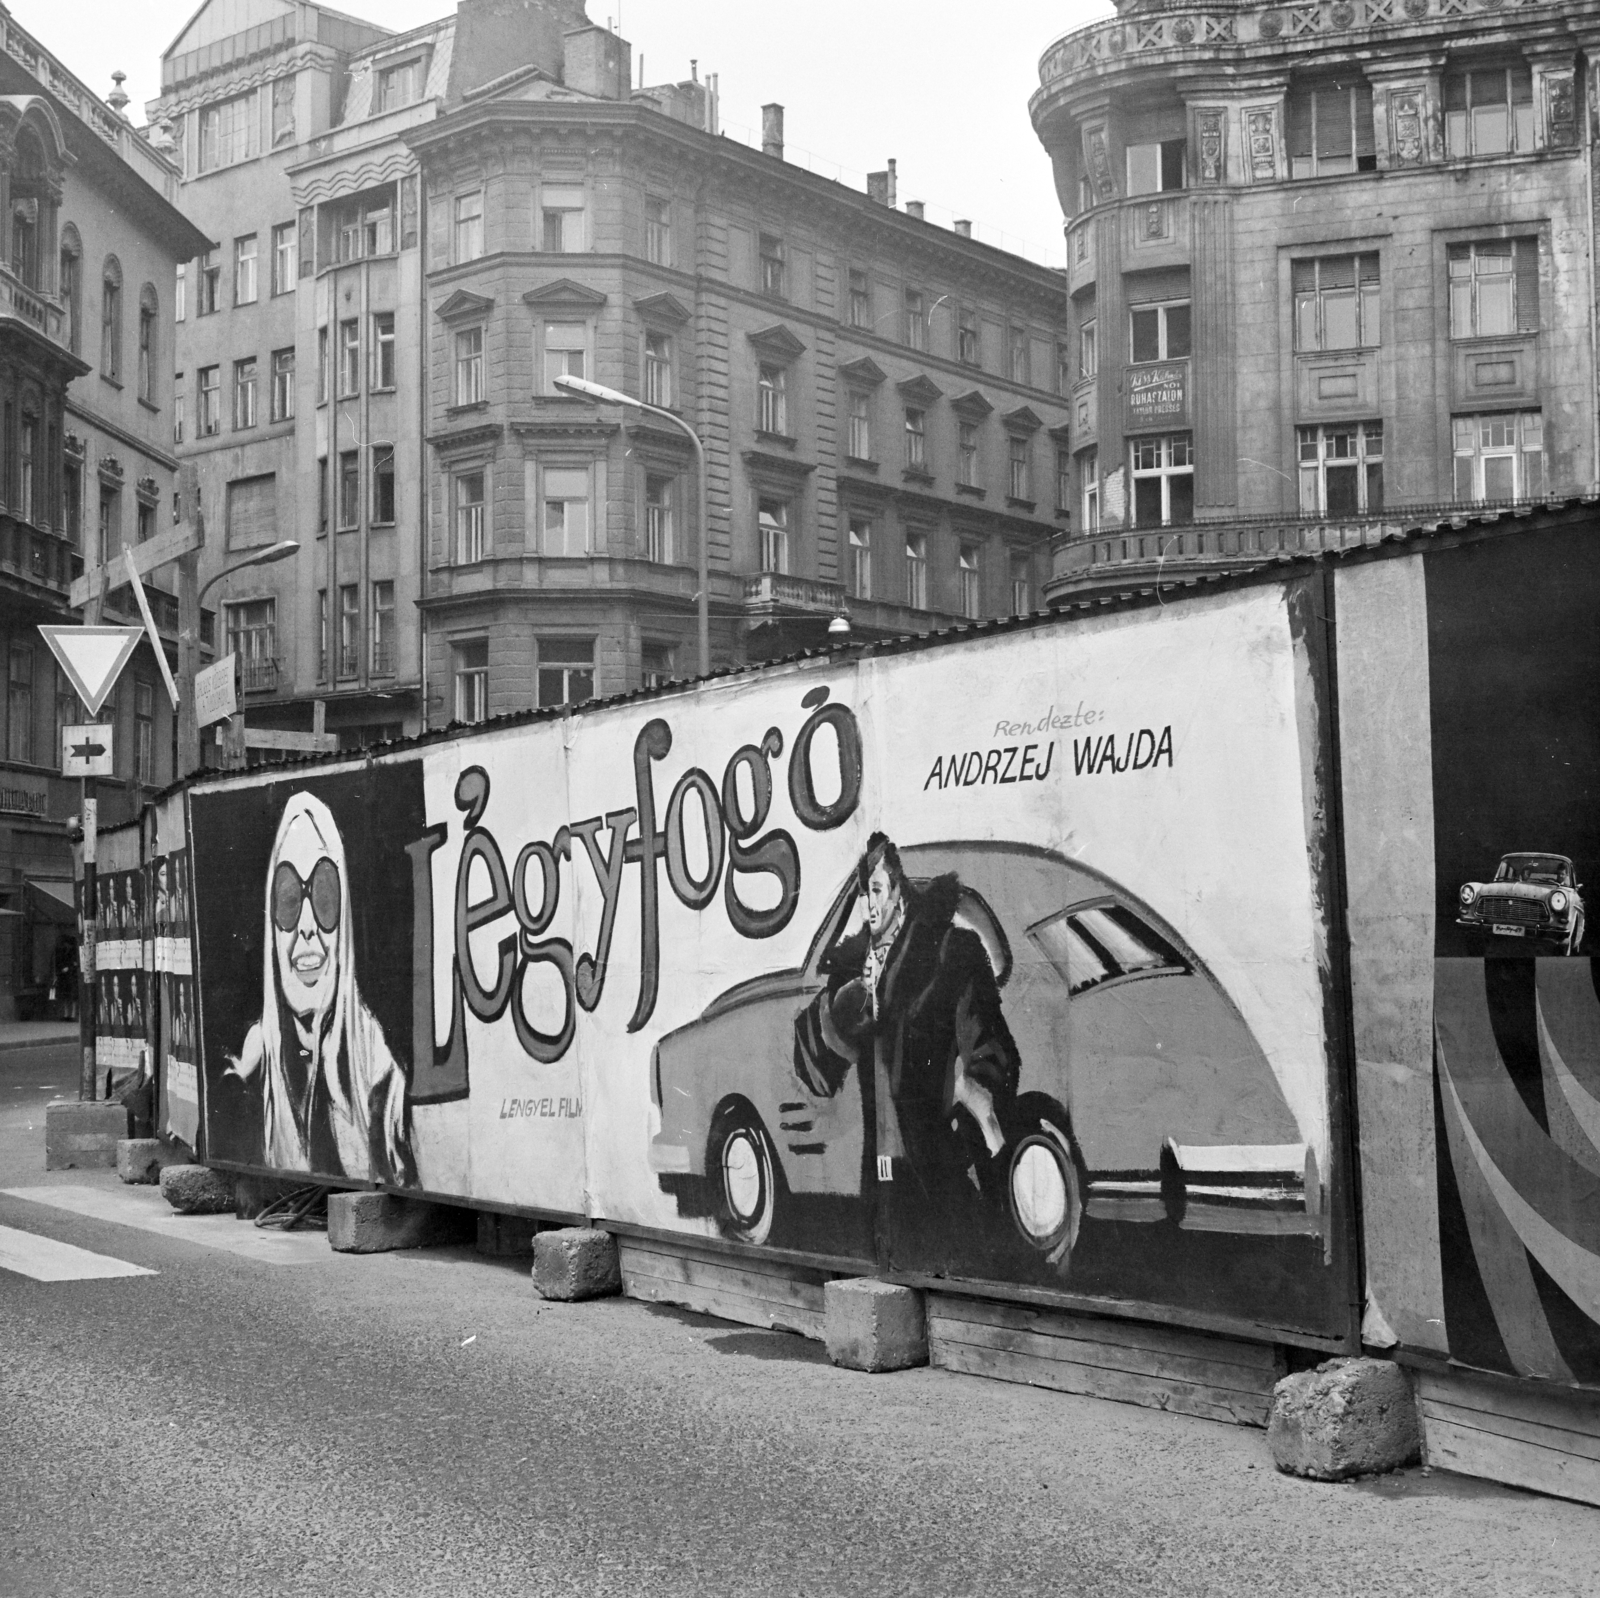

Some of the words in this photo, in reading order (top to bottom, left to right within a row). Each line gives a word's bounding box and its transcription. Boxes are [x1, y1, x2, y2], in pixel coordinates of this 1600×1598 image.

[1130, 389, 1183, 405] RUHASZALON
[993, 701, 1104, 738] Rendezte:
[923, 741, 1054, 791] ANDRZEJ
[1073, 725, 1173, 776] WAJDA
[404, 686, 863, 1105] Légyfogó
[499, 1098, 556, 1119] LENGYEL
